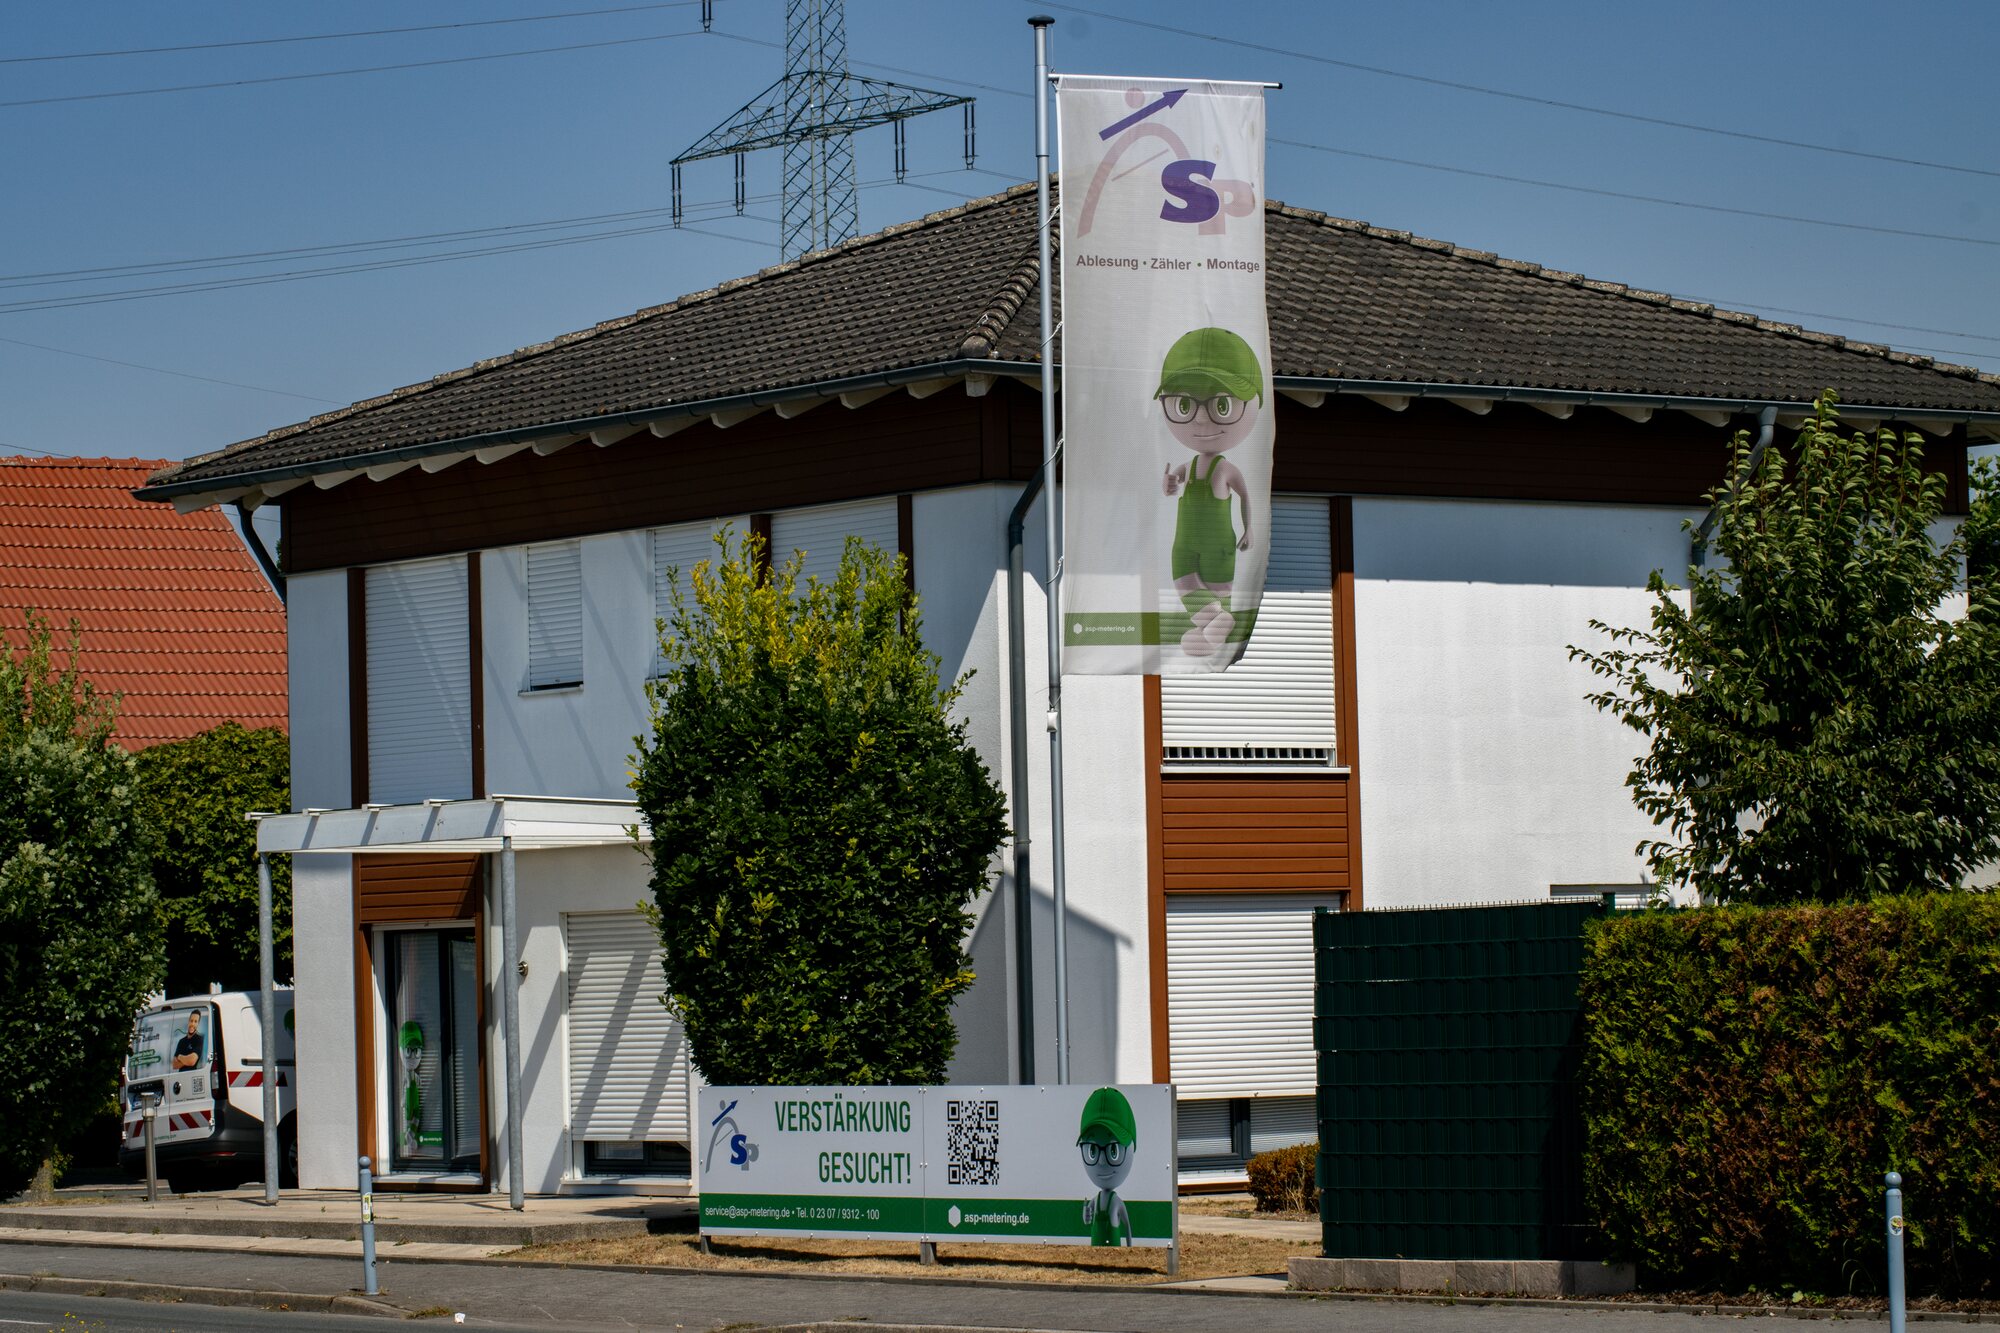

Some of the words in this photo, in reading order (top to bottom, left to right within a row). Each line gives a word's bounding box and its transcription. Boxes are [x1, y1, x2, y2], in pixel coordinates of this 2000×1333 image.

[1076, 254, 1139, 270] Ablesung
[1150, 257, 1192, 270] Zähler
[1206, 258, 1260, 273] Montage
[1084, 625, 1136, 633] asp-metering.de
[775, 1093, 911, 1133] VERSTÄRKUNG
[818, 1152, 911, 1184] GESUCHT!
[705, 1205, 790, 1220] service@asp-metering.de
[796, 1207, 808, 1218] Tel.
[810, 1208, 815, 1219] 0
[816, 1208, 826, 1219] 23
[826, 1208, 836, 1219] 07
[842, 1208, 860, 1220] 9312
[866, 1209, 880, 1220] 100
[964, 1212, 1030, 1226] asp-metering.de
